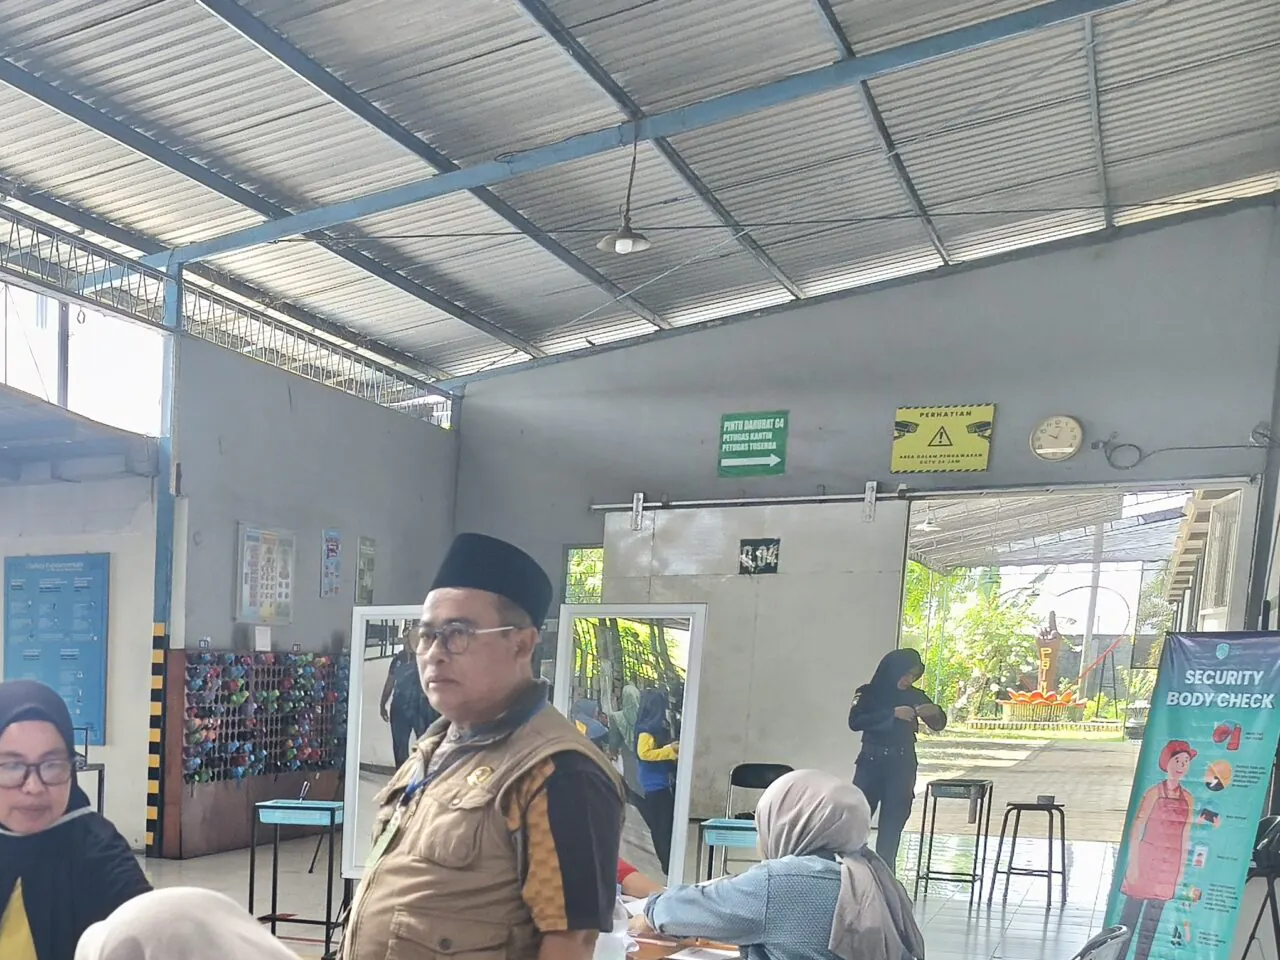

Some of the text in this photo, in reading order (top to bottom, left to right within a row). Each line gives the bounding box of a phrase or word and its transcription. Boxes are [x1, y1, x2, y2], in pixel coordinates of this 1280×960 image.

[724, 421, 744, 431] PINTU
[744, 419, 774, 430] DARURAT
[722, 432, 773, 442] PETUGAS KANTIN
[722, 443, 749, 452] PETUGAS
[1185, 670, 1264, 686] SECURITY
[1166, 692, 1276, 709] BODY CHECK
